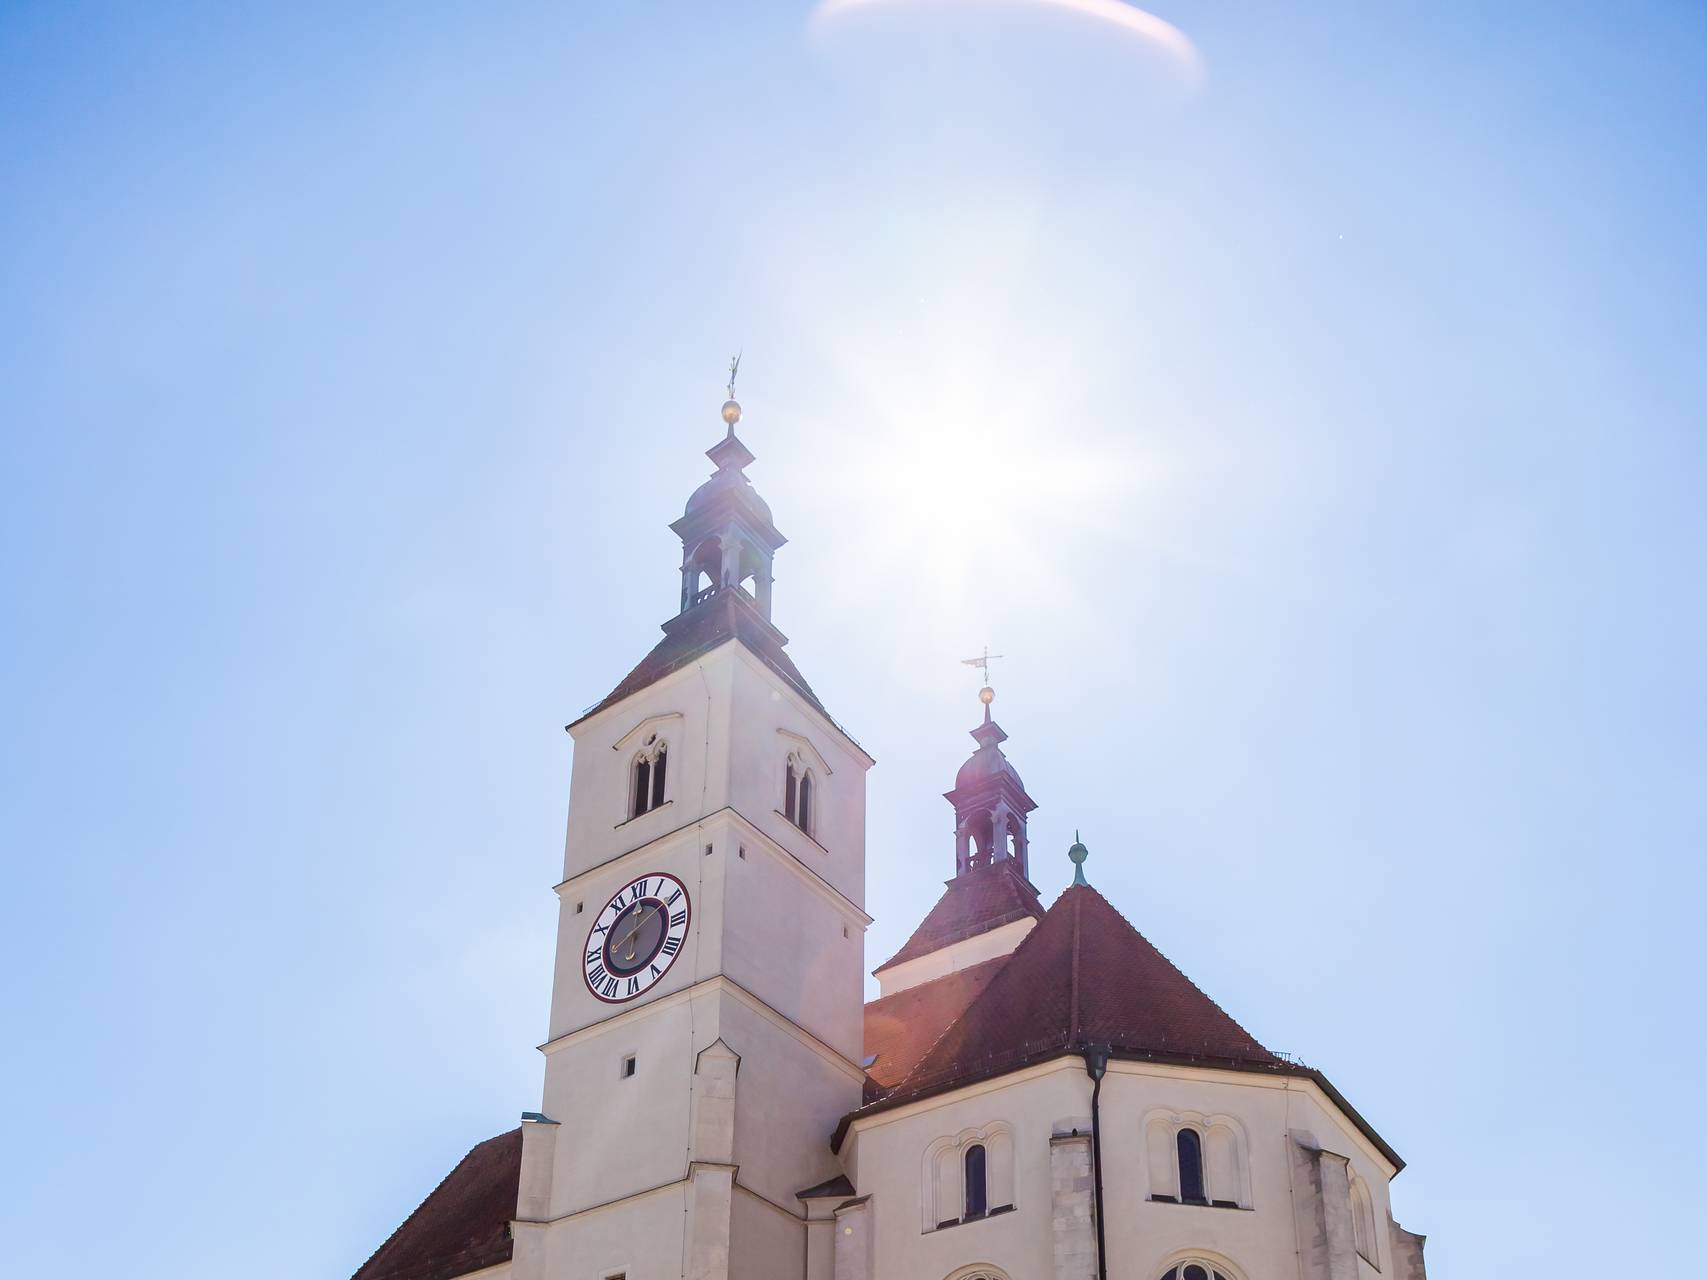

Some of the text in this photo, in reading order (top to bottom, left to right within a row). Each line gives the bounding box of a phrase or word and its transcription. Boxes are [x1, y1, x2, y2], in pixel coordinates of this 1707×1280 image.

[630, 879, 648, 902] XII
[654, 878, 664, 896] I
[610, 895, 626, 916] XI
[668, 888, 682, 906] II
[670, 909, 686, 928] III
[593, 923, 610, 936] X
[587, 946, 602, 965] IX
[589, 964, 607, 990] VIII
[650, 964, 662, 980] V
[601, 977, 620, 997] VII
[627, 977, 640, 995] VI
